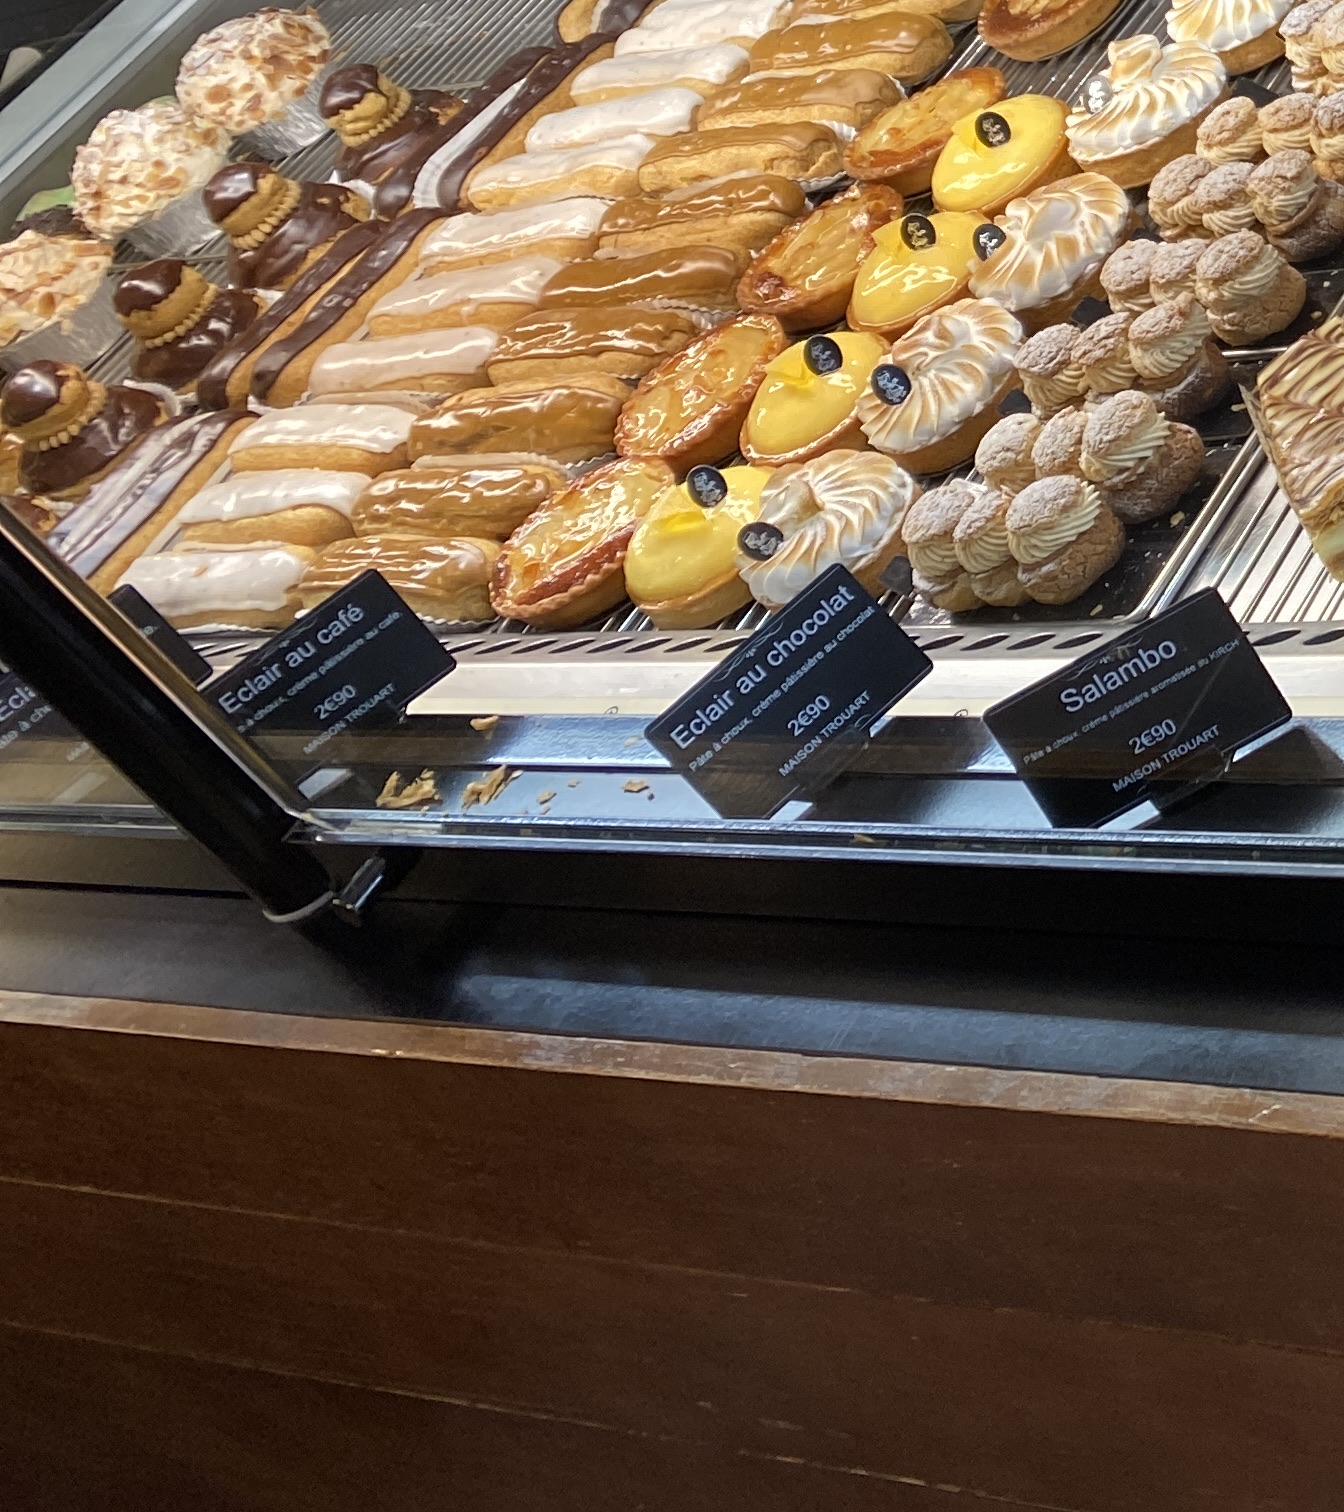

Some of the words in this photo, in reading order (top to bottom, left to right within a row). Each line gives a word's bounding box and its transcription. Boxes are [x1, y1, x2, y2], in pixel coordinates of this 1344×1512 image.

[220, 663, 283, 714] Eclair
[285, 641, 317, 668] au
[317, 603, 364, 645] café
[670, 690, 737, 750] Eclair
[736, 666, 767, 695] au
[766, 584, 856, 668] chocolat
[752, 688, 781, 717] crème
[781, 652, 825, 693] pâtissière
[824, 638, 837, 653] au
[836, 605, 875, 640] chocolat
[1060, 640, 1178, 713] Salambo
[1209, 639, 1240, 661] KIRCH
[303, 721, 346, 754] MAISON
[345, 683, 397, 723] TROUART
[314, 684, 358, 720] 2€90
[778, 736, 822, 777] MAISON
[820, 690, 871, 739] TROUART
[787, 695, 831, 737] 2€90
[1129, 718, 1177, 755] 2€90
[1112, 757, 1162, 793] MAISON
[1160, 724, 1221, 766] TROUART
